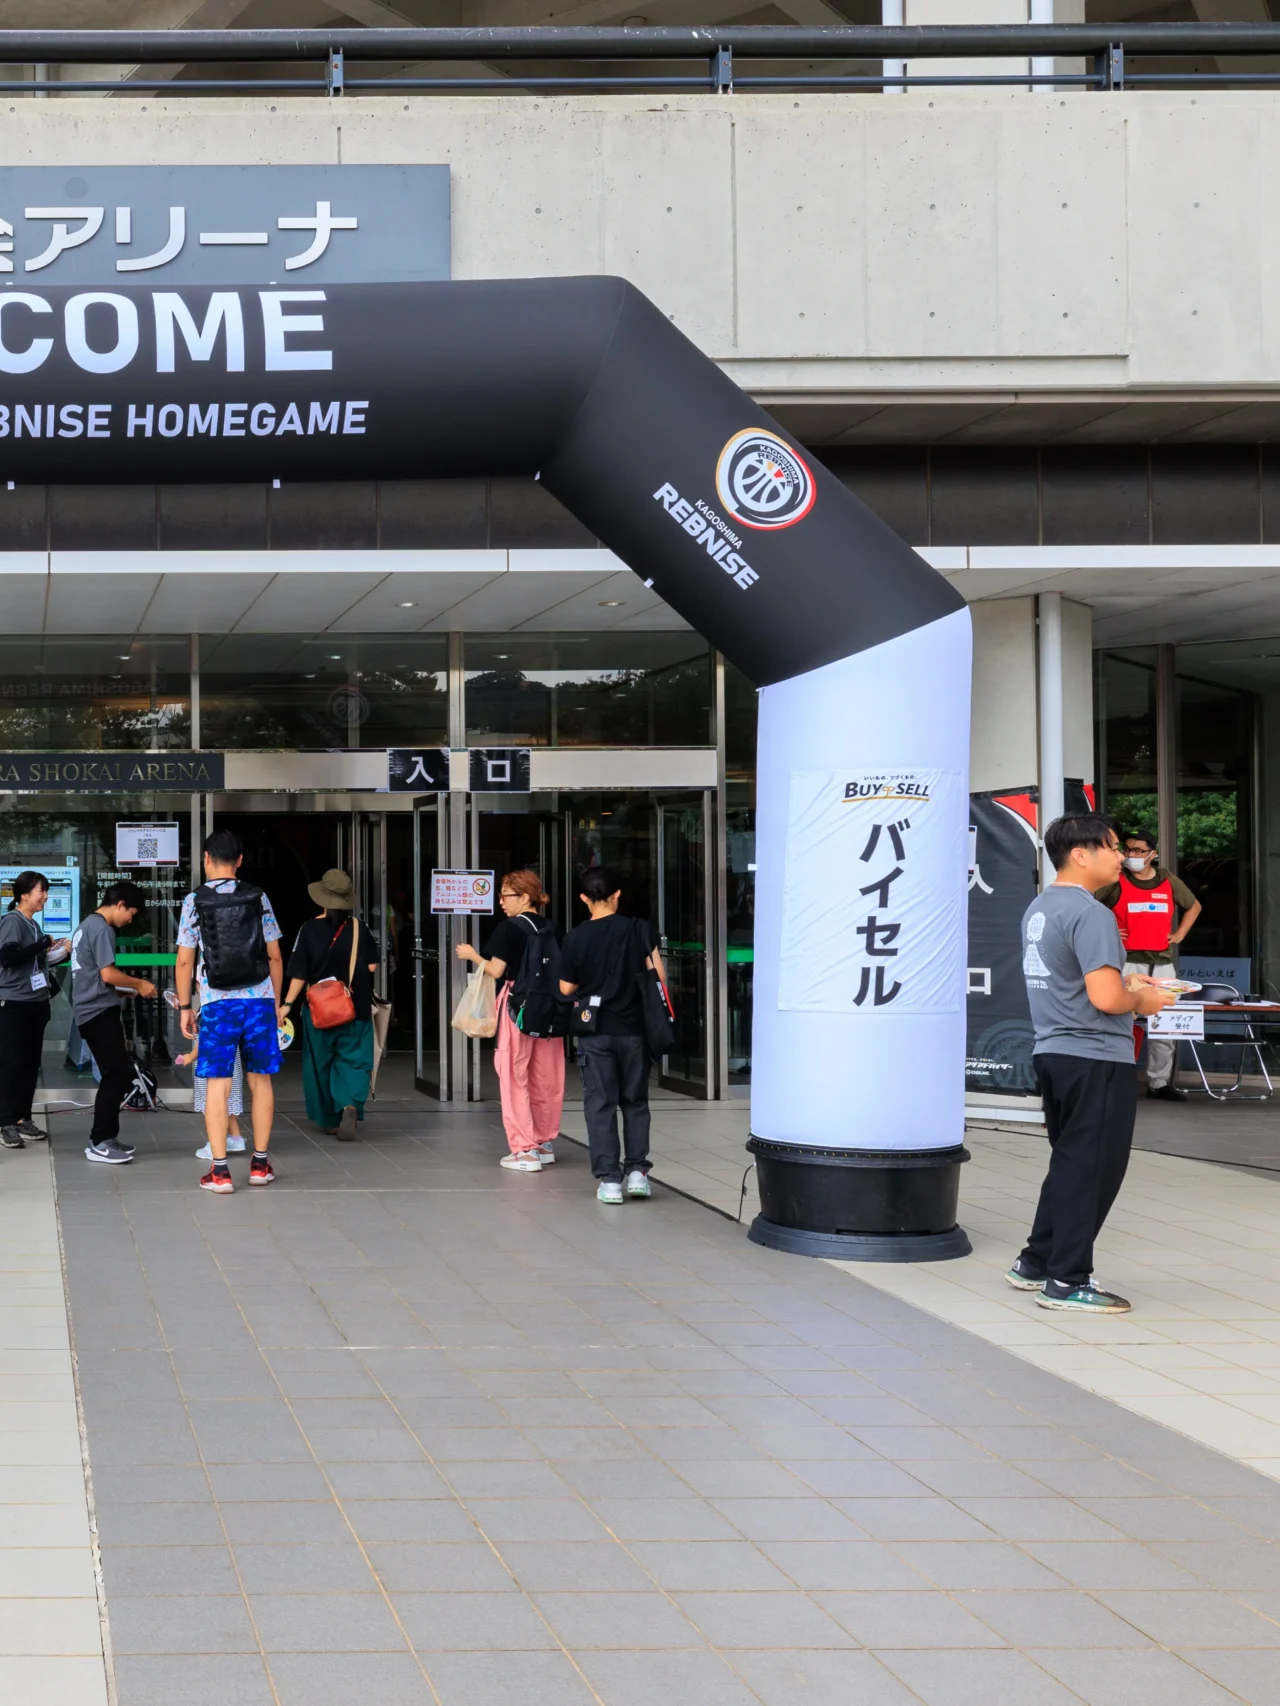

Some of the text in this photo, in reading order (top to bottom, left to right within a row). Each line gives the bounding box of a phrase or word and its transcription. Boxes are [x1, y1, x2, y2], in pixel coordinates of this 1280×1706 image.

[127, 400, 370, 437] HOMEGAME
[757, 452, 793, 488] REBNISE
[759, 444, 799, 484] KAGOSHIMA
[652, 482, 760, 590] REBNISE
[695, 499, 743, 549] KAGOSHIMA
[29, 763, 122, 781] SHOKAI
[129, 763, 211, 781] ARENA
[406, 756, 511, 784] 入口
[852, 818, 911, 1007] バイセル
